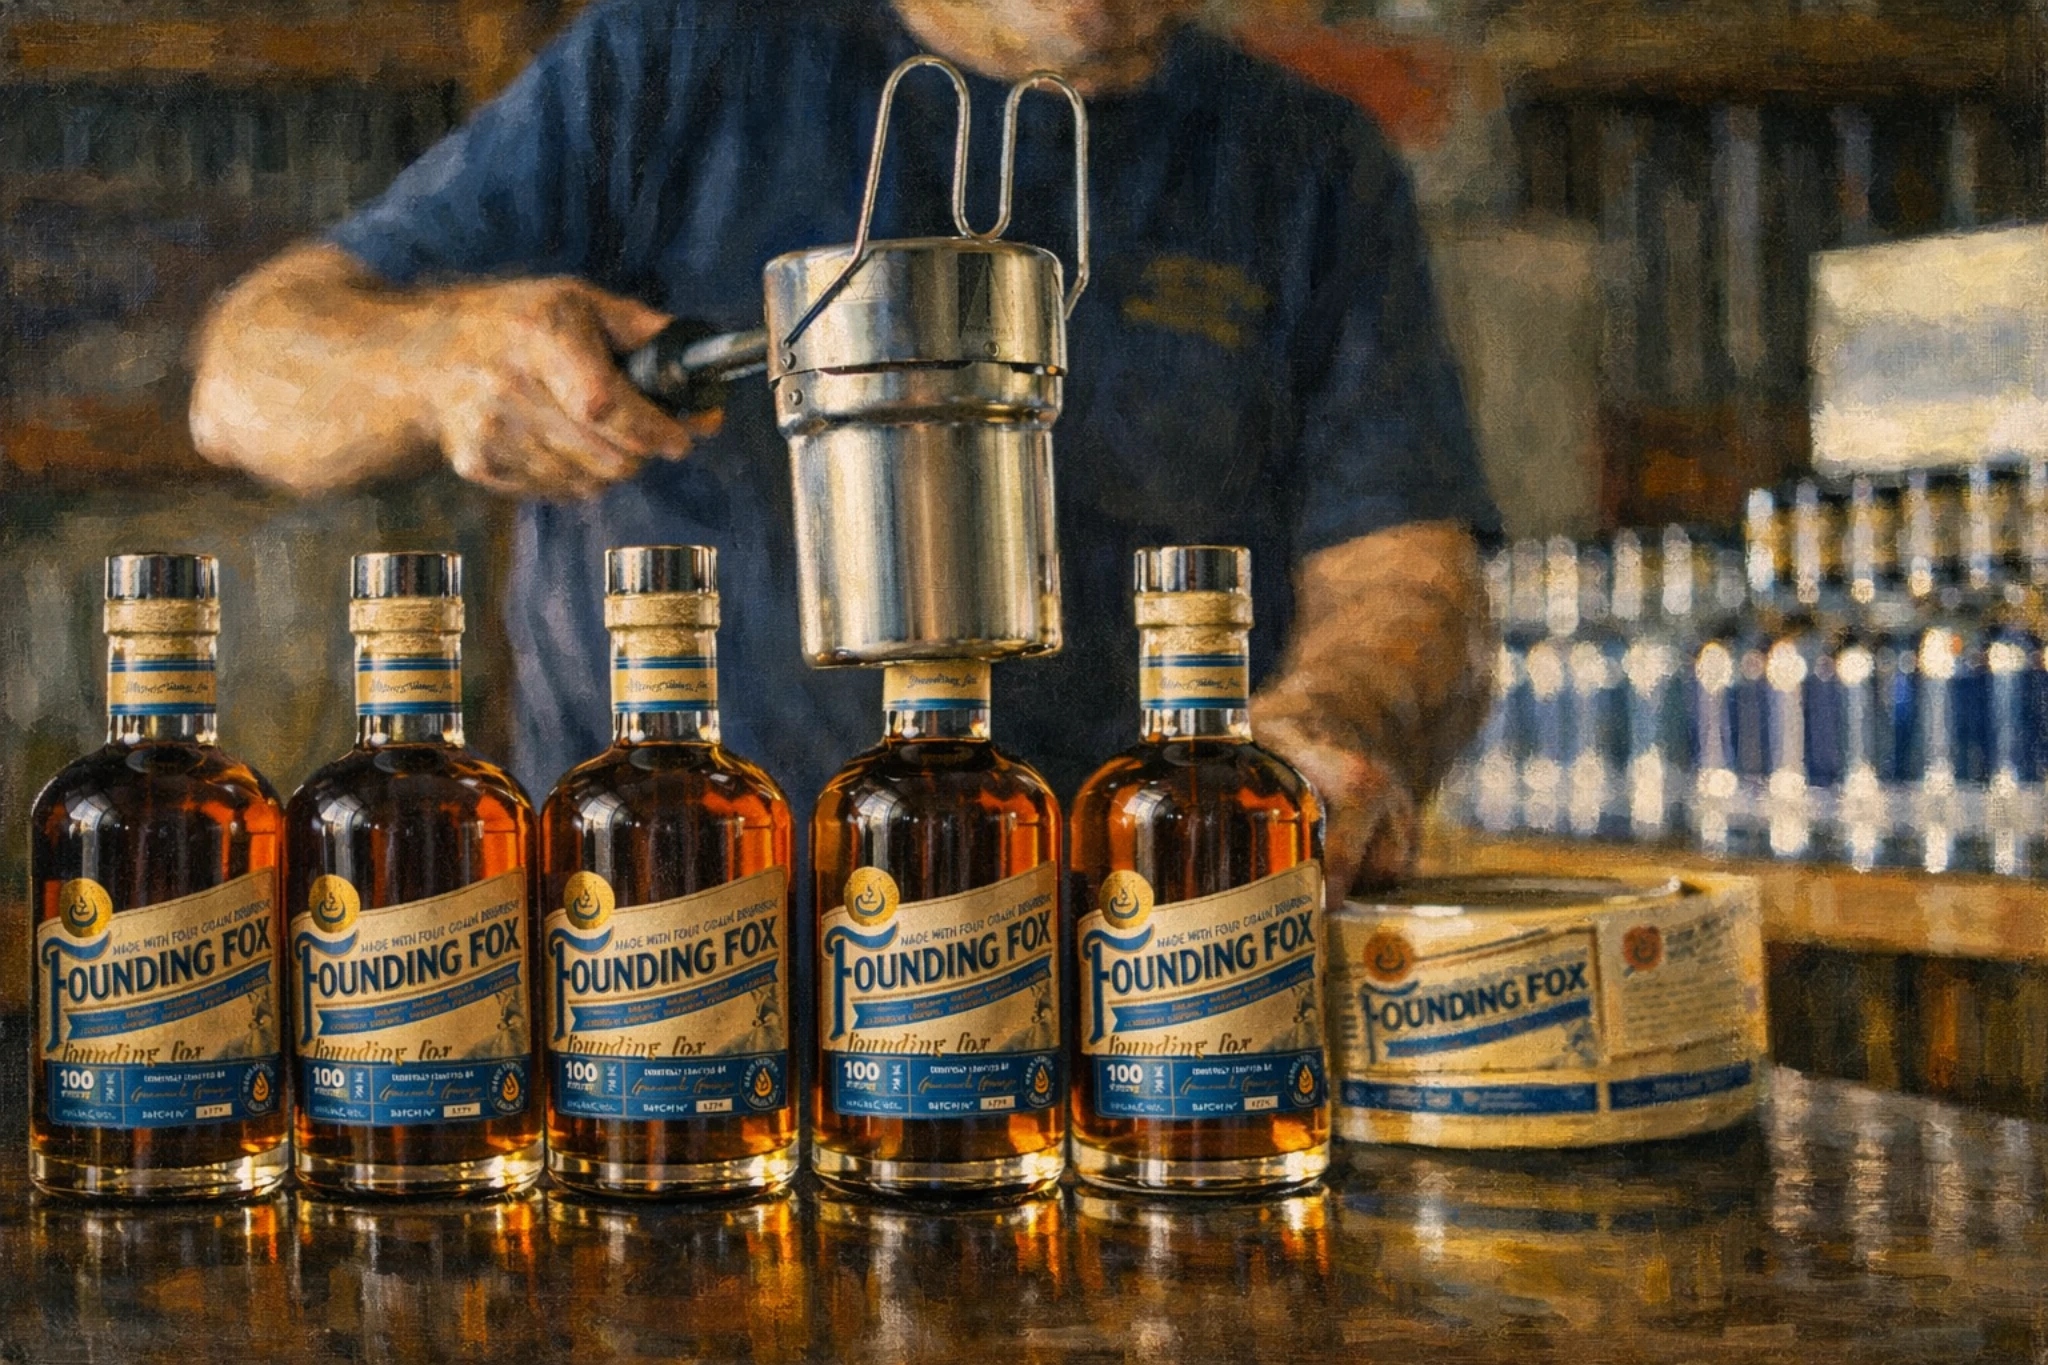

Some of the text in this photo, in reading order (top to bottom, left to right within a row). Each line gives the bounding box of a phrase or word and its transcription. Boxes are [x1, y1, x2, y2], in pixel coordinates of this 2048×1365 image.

[42, 930, 216, 1053] FOUNDING
[222, 916, 272, 966] FOX
[295, 927, 463, 1046] FOUNDING
[469, 916, 521, 968] FOX
[549, 925, 717, 1042] FOUNDING
[724, 916, 779, 966] FOX
[825, 921, 999, 1041] FOUNDING
[1007, 909, 1051, 961] FOX
[1083, 923, 1257, 1045] FOUNDING
[1264, 910, 1315, 962] FOX
[1361, 979, 1521, 1065] FOUNDING
[1527, 962, 1590, 1002] FOX
[60, 1070, 94, 1088] 100
[312, 1066, 345, 1087] 100
[565, 1061, 597, 1081] 100
[844, 1061, 880, 1080] 100
[1107, 1064, 1142, 1083] 100
